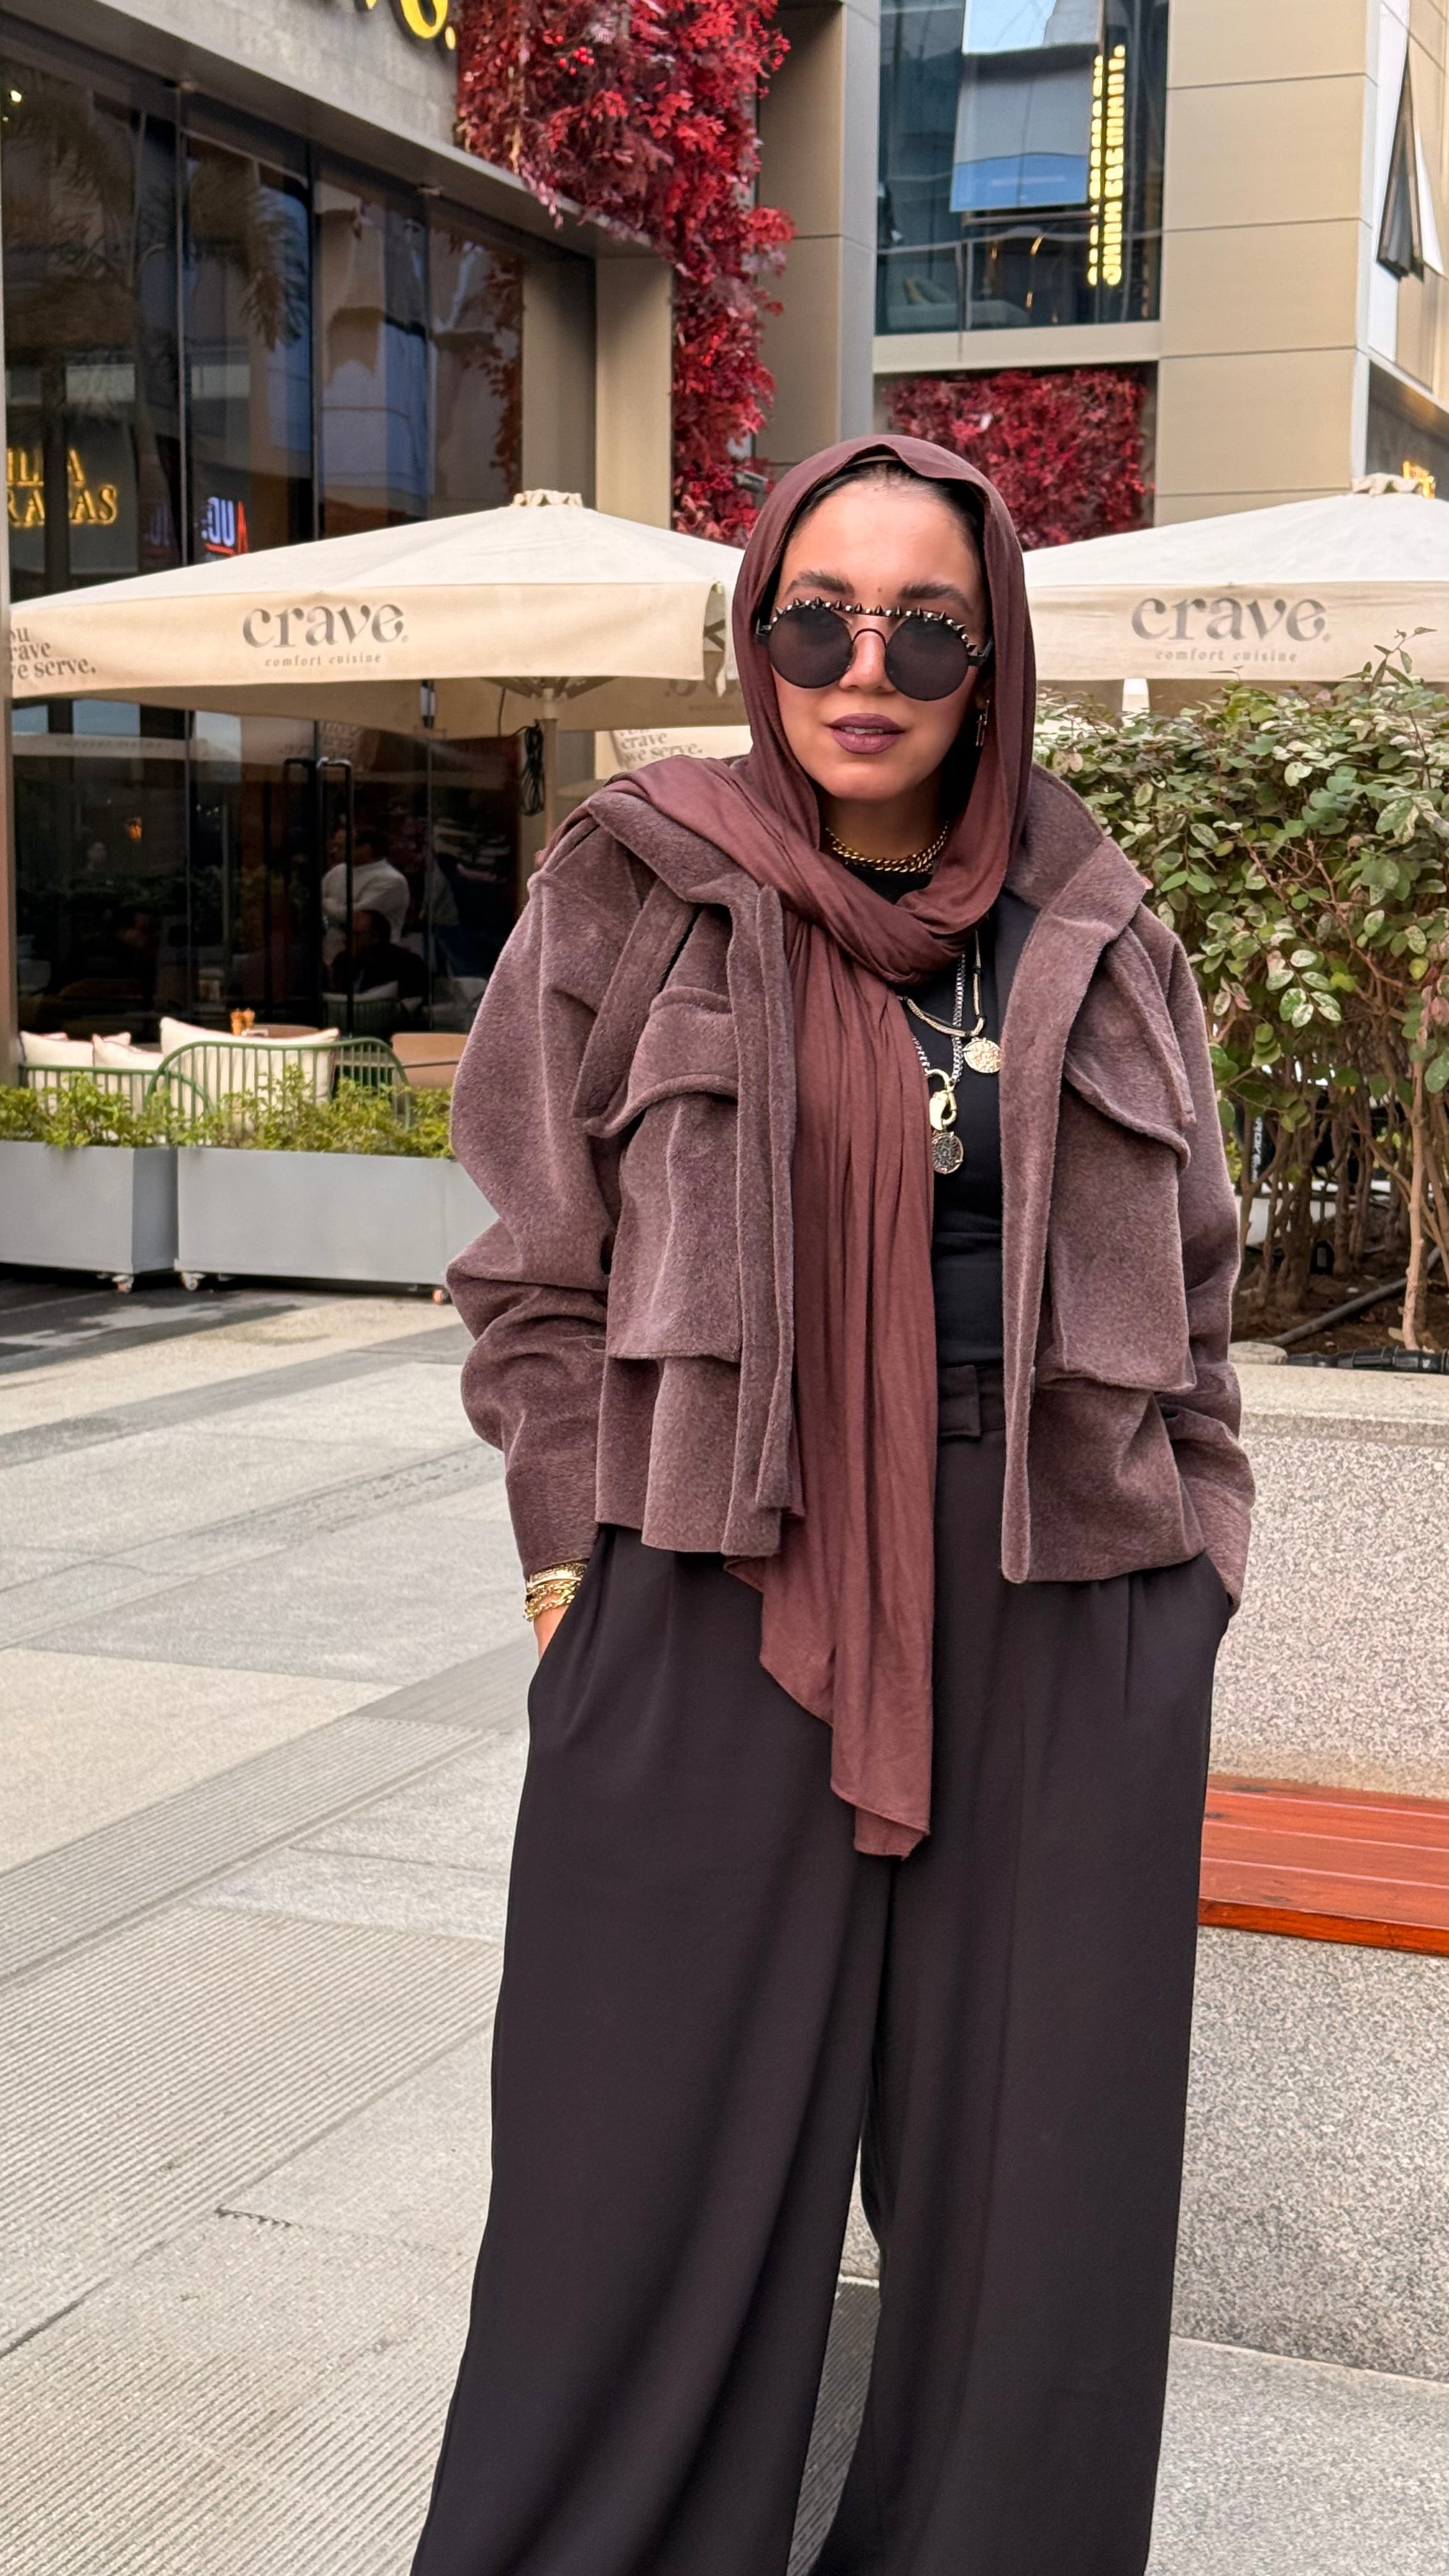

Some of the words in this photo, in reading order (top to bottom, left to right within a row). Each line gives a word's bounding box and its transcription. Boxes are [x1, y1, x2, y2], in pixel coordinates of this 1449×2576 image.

[264, 655, 321, 667] comfort
[328, 652, 381, 664] cuisine
[1155, 648, 1224, 661] comfort
[1232, 649, 1298, 662] cuisine
[33, 659, 96, 678] serve.
[620, 732, 668, 750] crave
